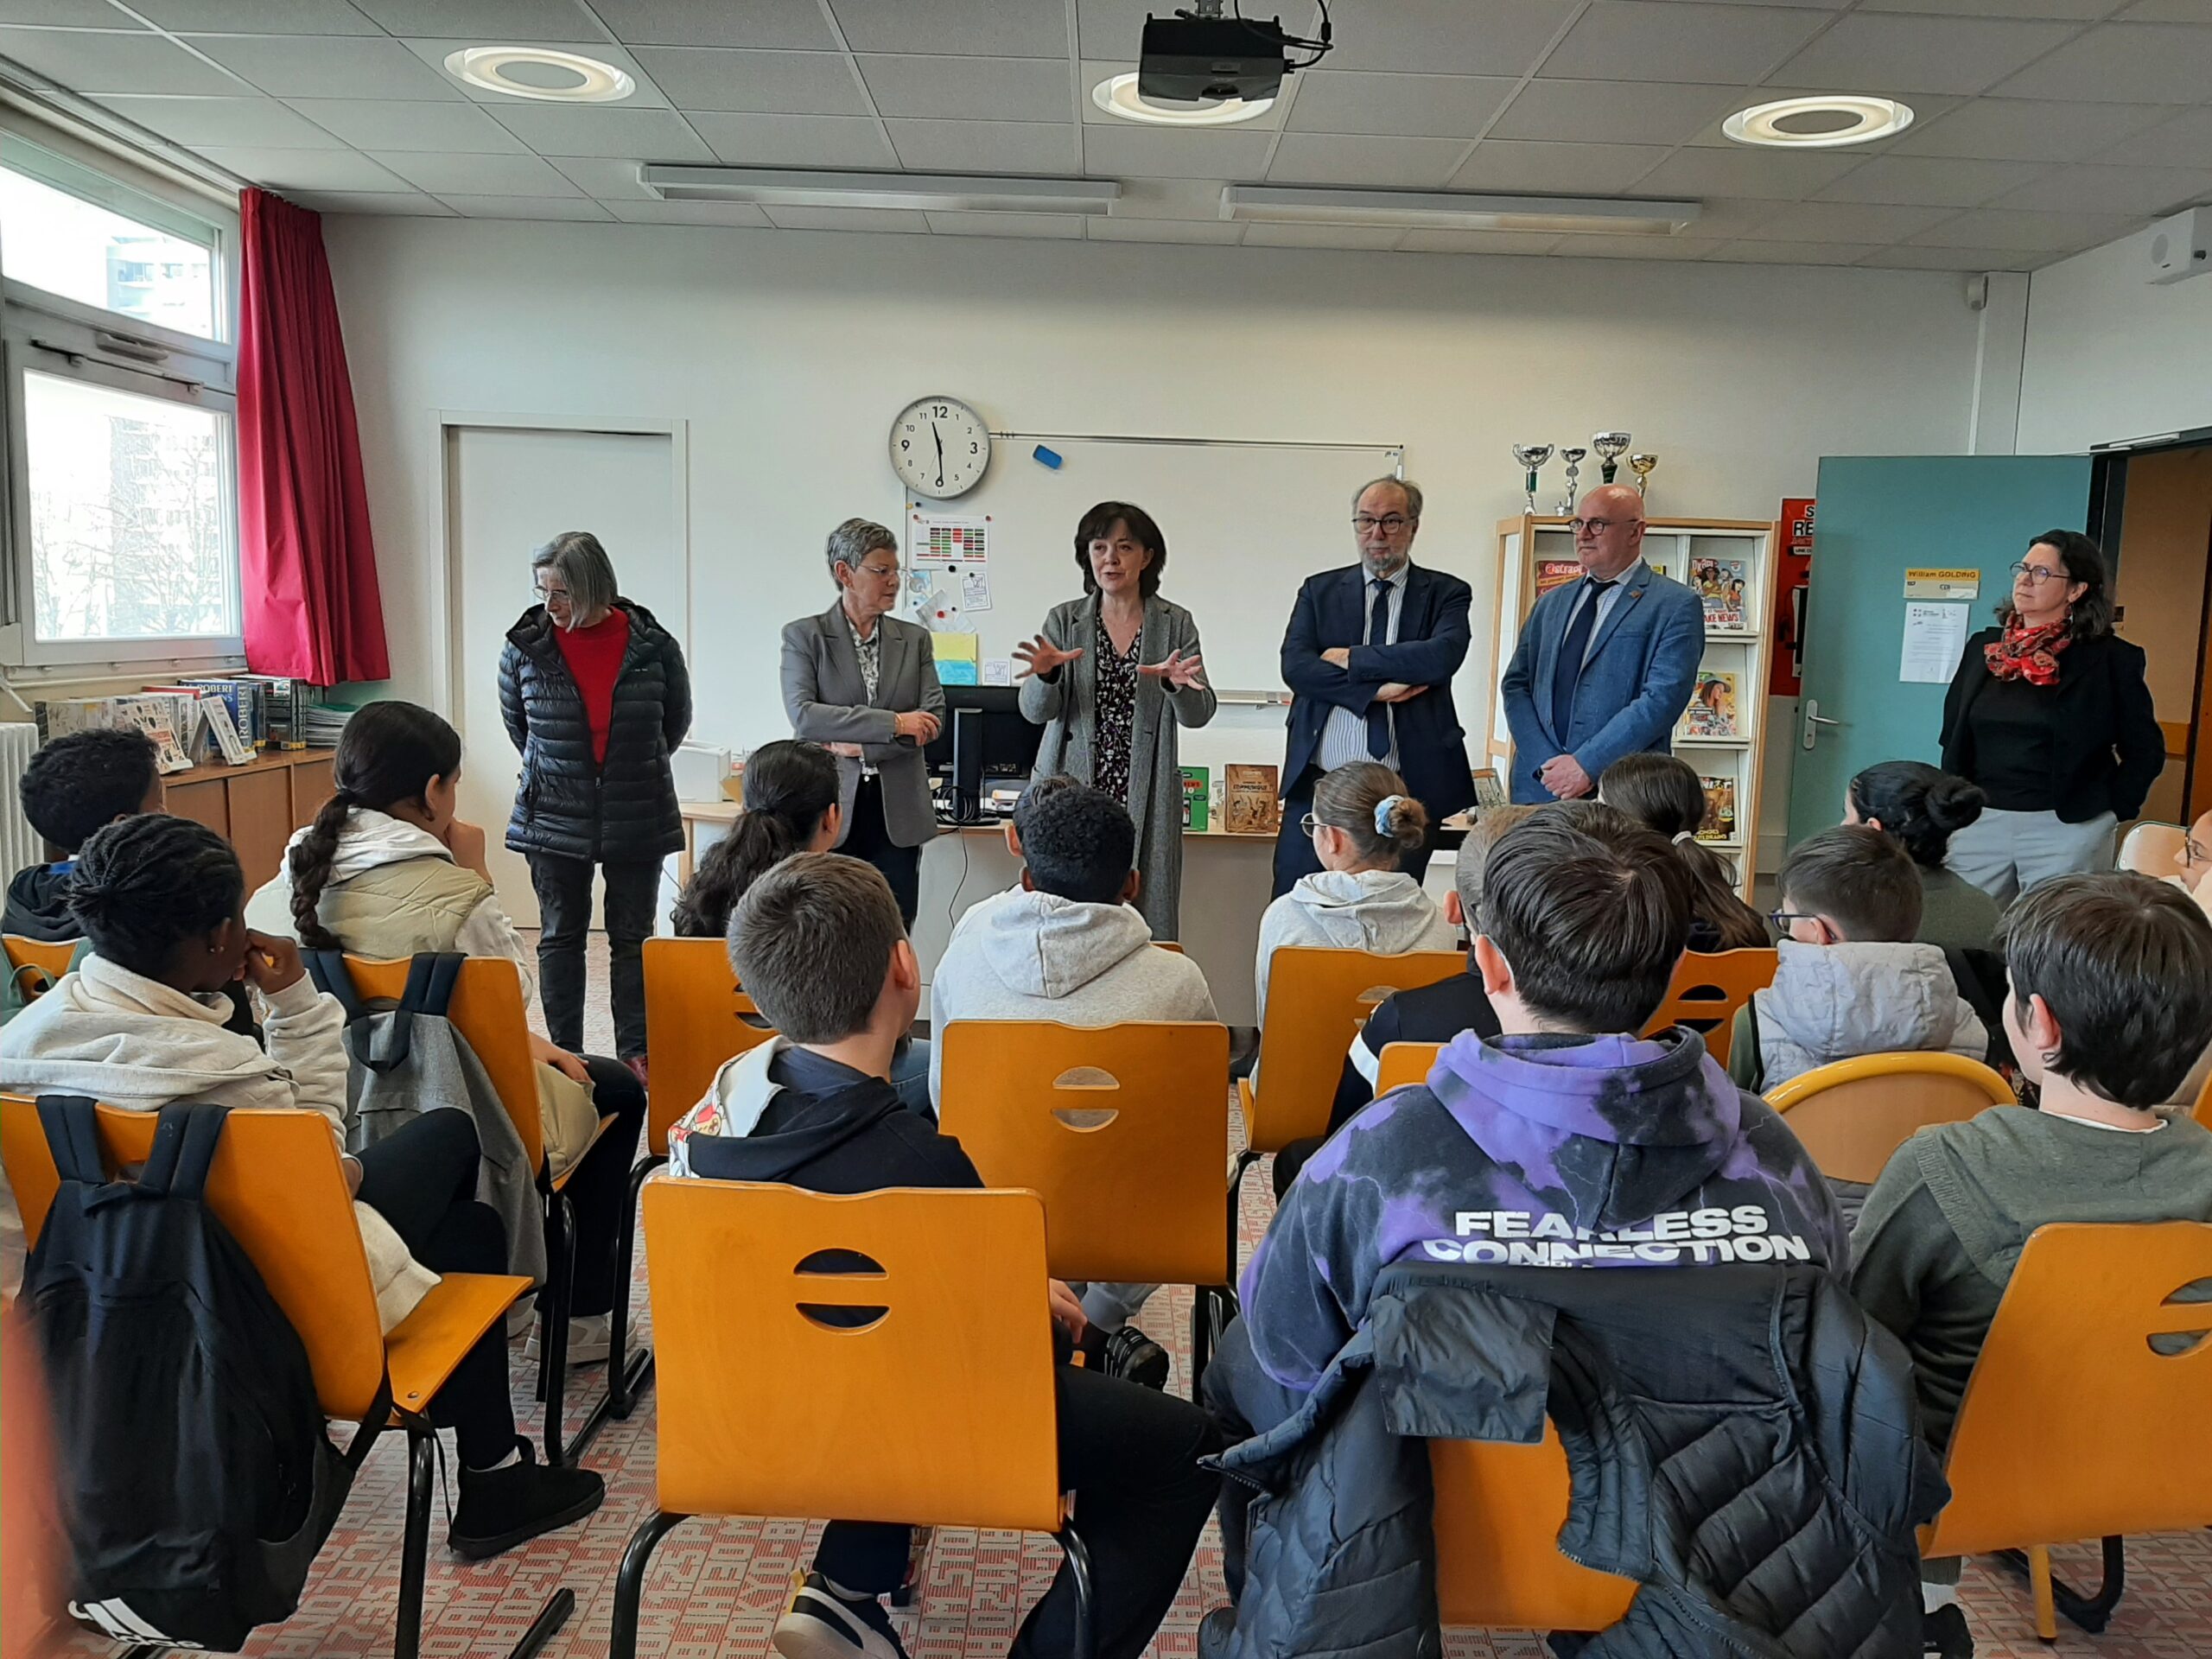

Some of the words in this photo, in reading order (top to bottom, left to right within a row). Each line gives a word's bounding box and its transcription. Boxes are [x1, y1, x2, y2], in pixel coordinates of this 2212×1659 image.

[932, 406, 948, 417] 12
[901, 440, 910, 451] 9
[970, 442, 977, 454] 3
[935, 477, 944, 486] 6
[197, 683, 232, 692] ROBERT
[1422, 1234, 1811, 1266] CONNECTION
